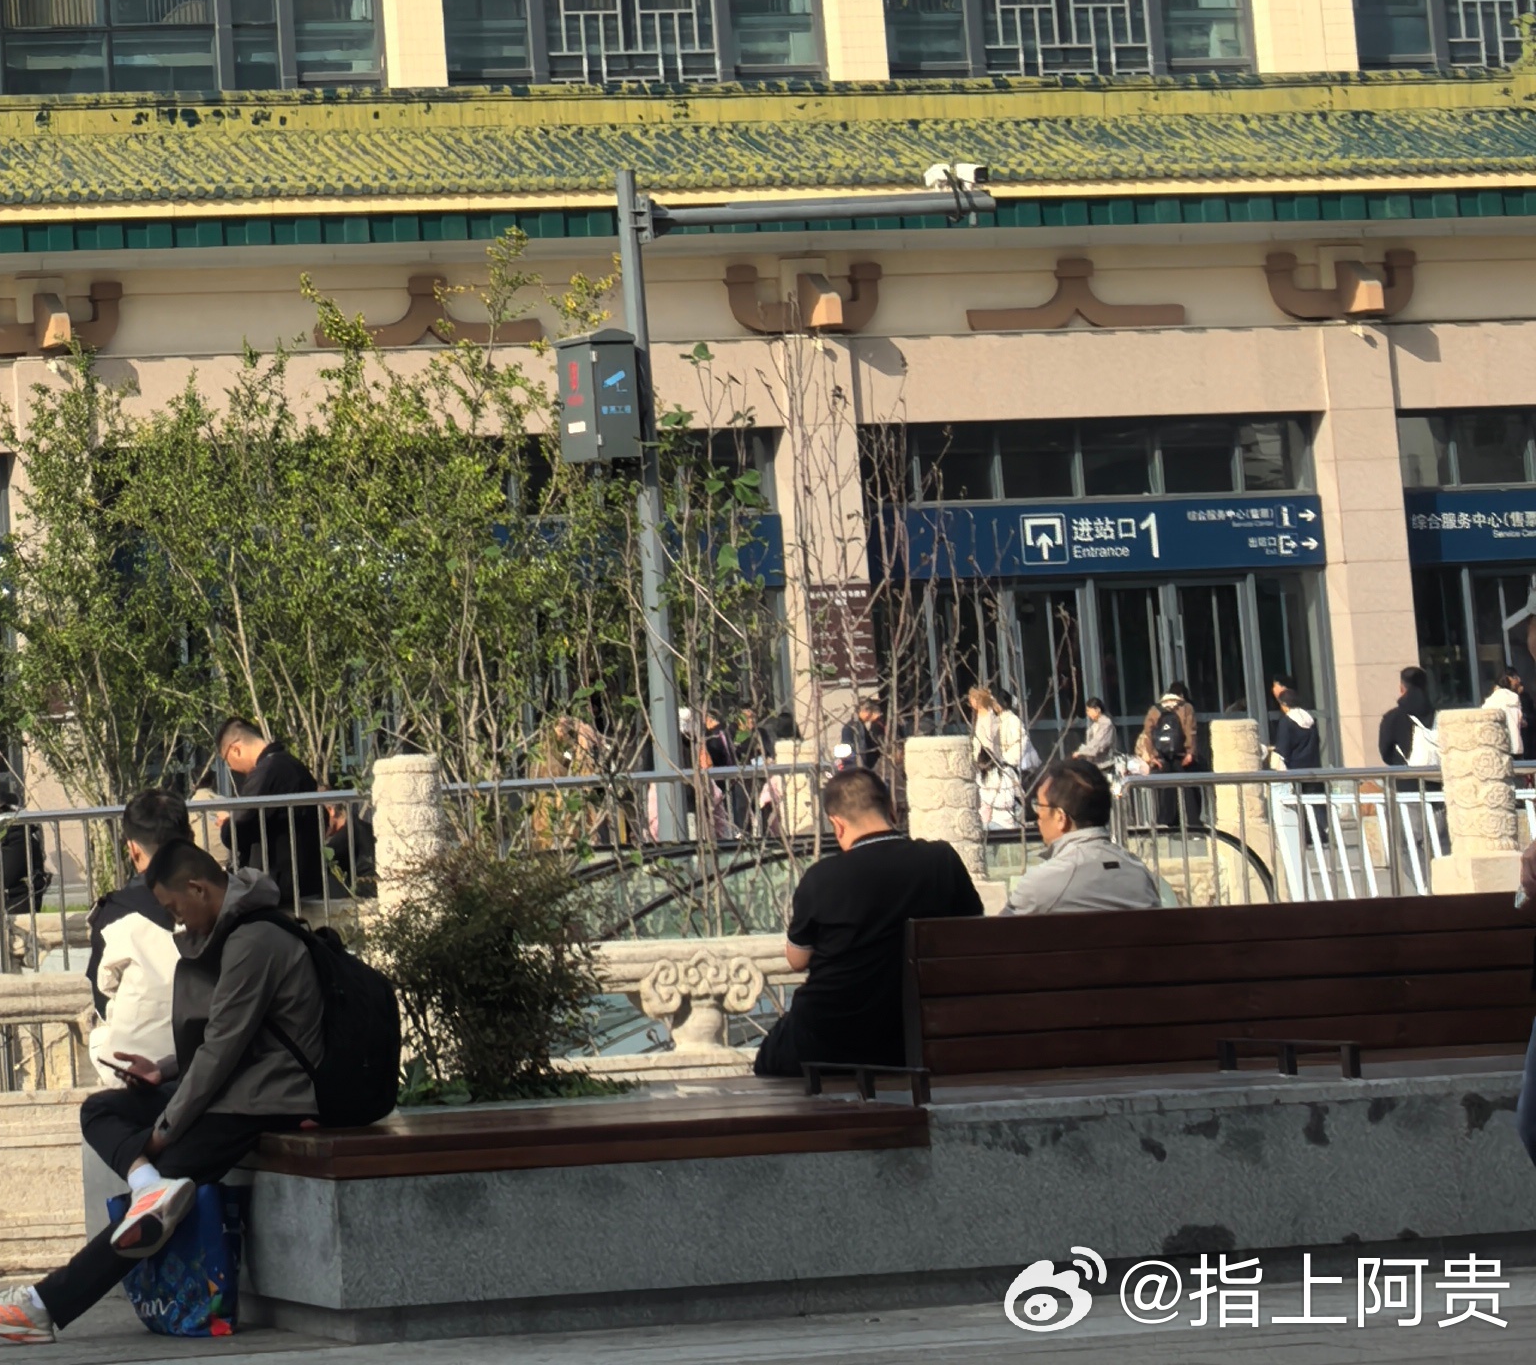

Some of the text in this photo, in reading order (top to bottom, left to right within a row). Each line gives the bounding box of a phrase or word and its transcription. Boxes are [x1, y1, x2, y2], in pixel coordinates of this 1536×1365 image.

[1072, 511, 1160, 559] 进站口 1
[1072, 544, 1130, 558] Entrance
